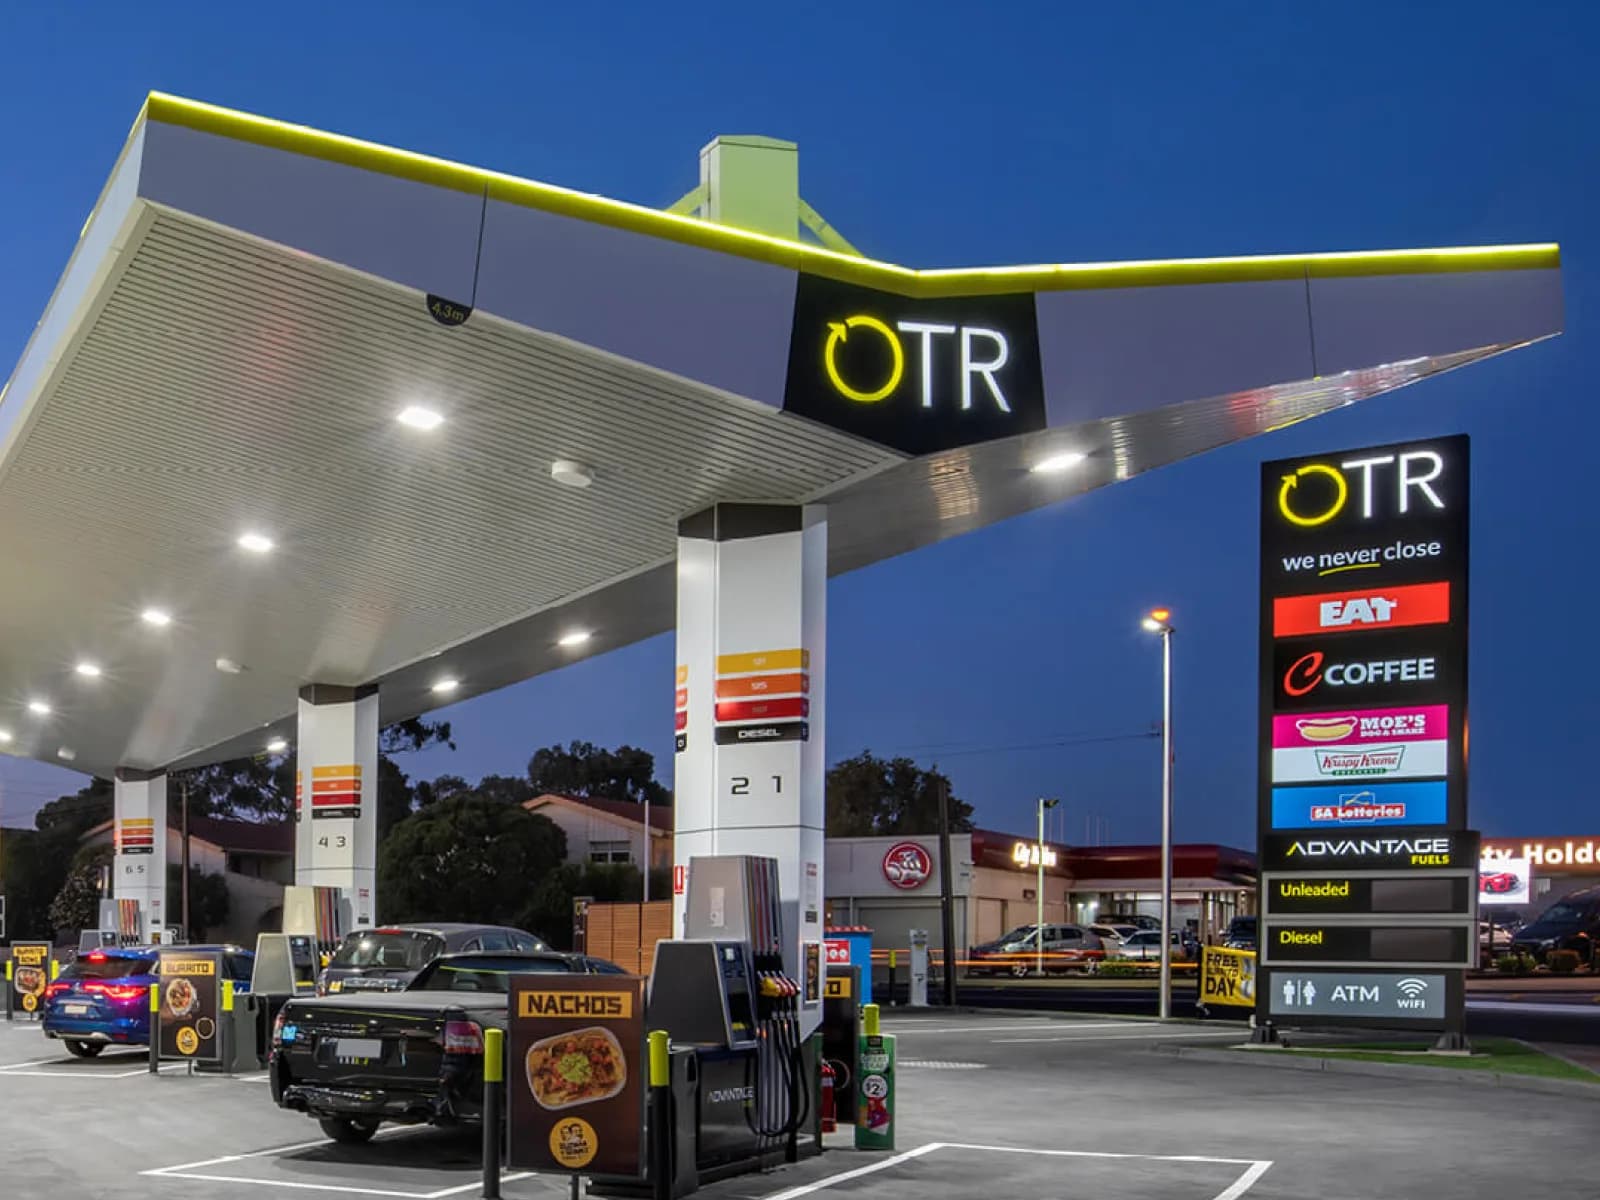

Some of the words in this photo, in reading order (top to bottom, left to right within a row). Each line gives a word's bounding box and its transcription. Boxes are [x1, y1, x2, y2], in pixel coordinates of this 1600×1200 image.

[825, 315, 1011, 413] OTR
[1279, 451, 1445, 527] OTR
[1282, 555, 1315, 571] we
[1319, 548, 1381, 567] never
[1384, 541, 1441, 561] close
[1319, 597, 1398, 627] EAT
[1325, 657, 1436, 686] COFFEE
[1360, 714, 1425, 729] MOE'S
[738, 728, 782, 739] DIESEL
[1322, 754, 1359, 768] Krispy
[1360, 752, 1398, 768] Kreme
[731, 776, 749, 795] 2
[771, 775, 782, 793] 1
[1314, 807, 1333, 818] SA
[1337, 803, 1401, 818] Lotteries
[318, 836, 328, 848] 4
[336, 836, 346, 848] 3
[1286, 839, 1450, 856] ADVANTAGE
[1411, 855, 1450, 865] FUELS
[1523, 842, 1600, 865] Hold
[1280, 881, 1350, 897] Unleaded
[1280, 931, 1322, 944] Diesel
[1207, 953, 1238, 967] FREE
[1206, 976, 1236, 996] DAY
[1331, 985, 1380, 1002] ATM
[528, 994, 621, 1014] NACHOS
